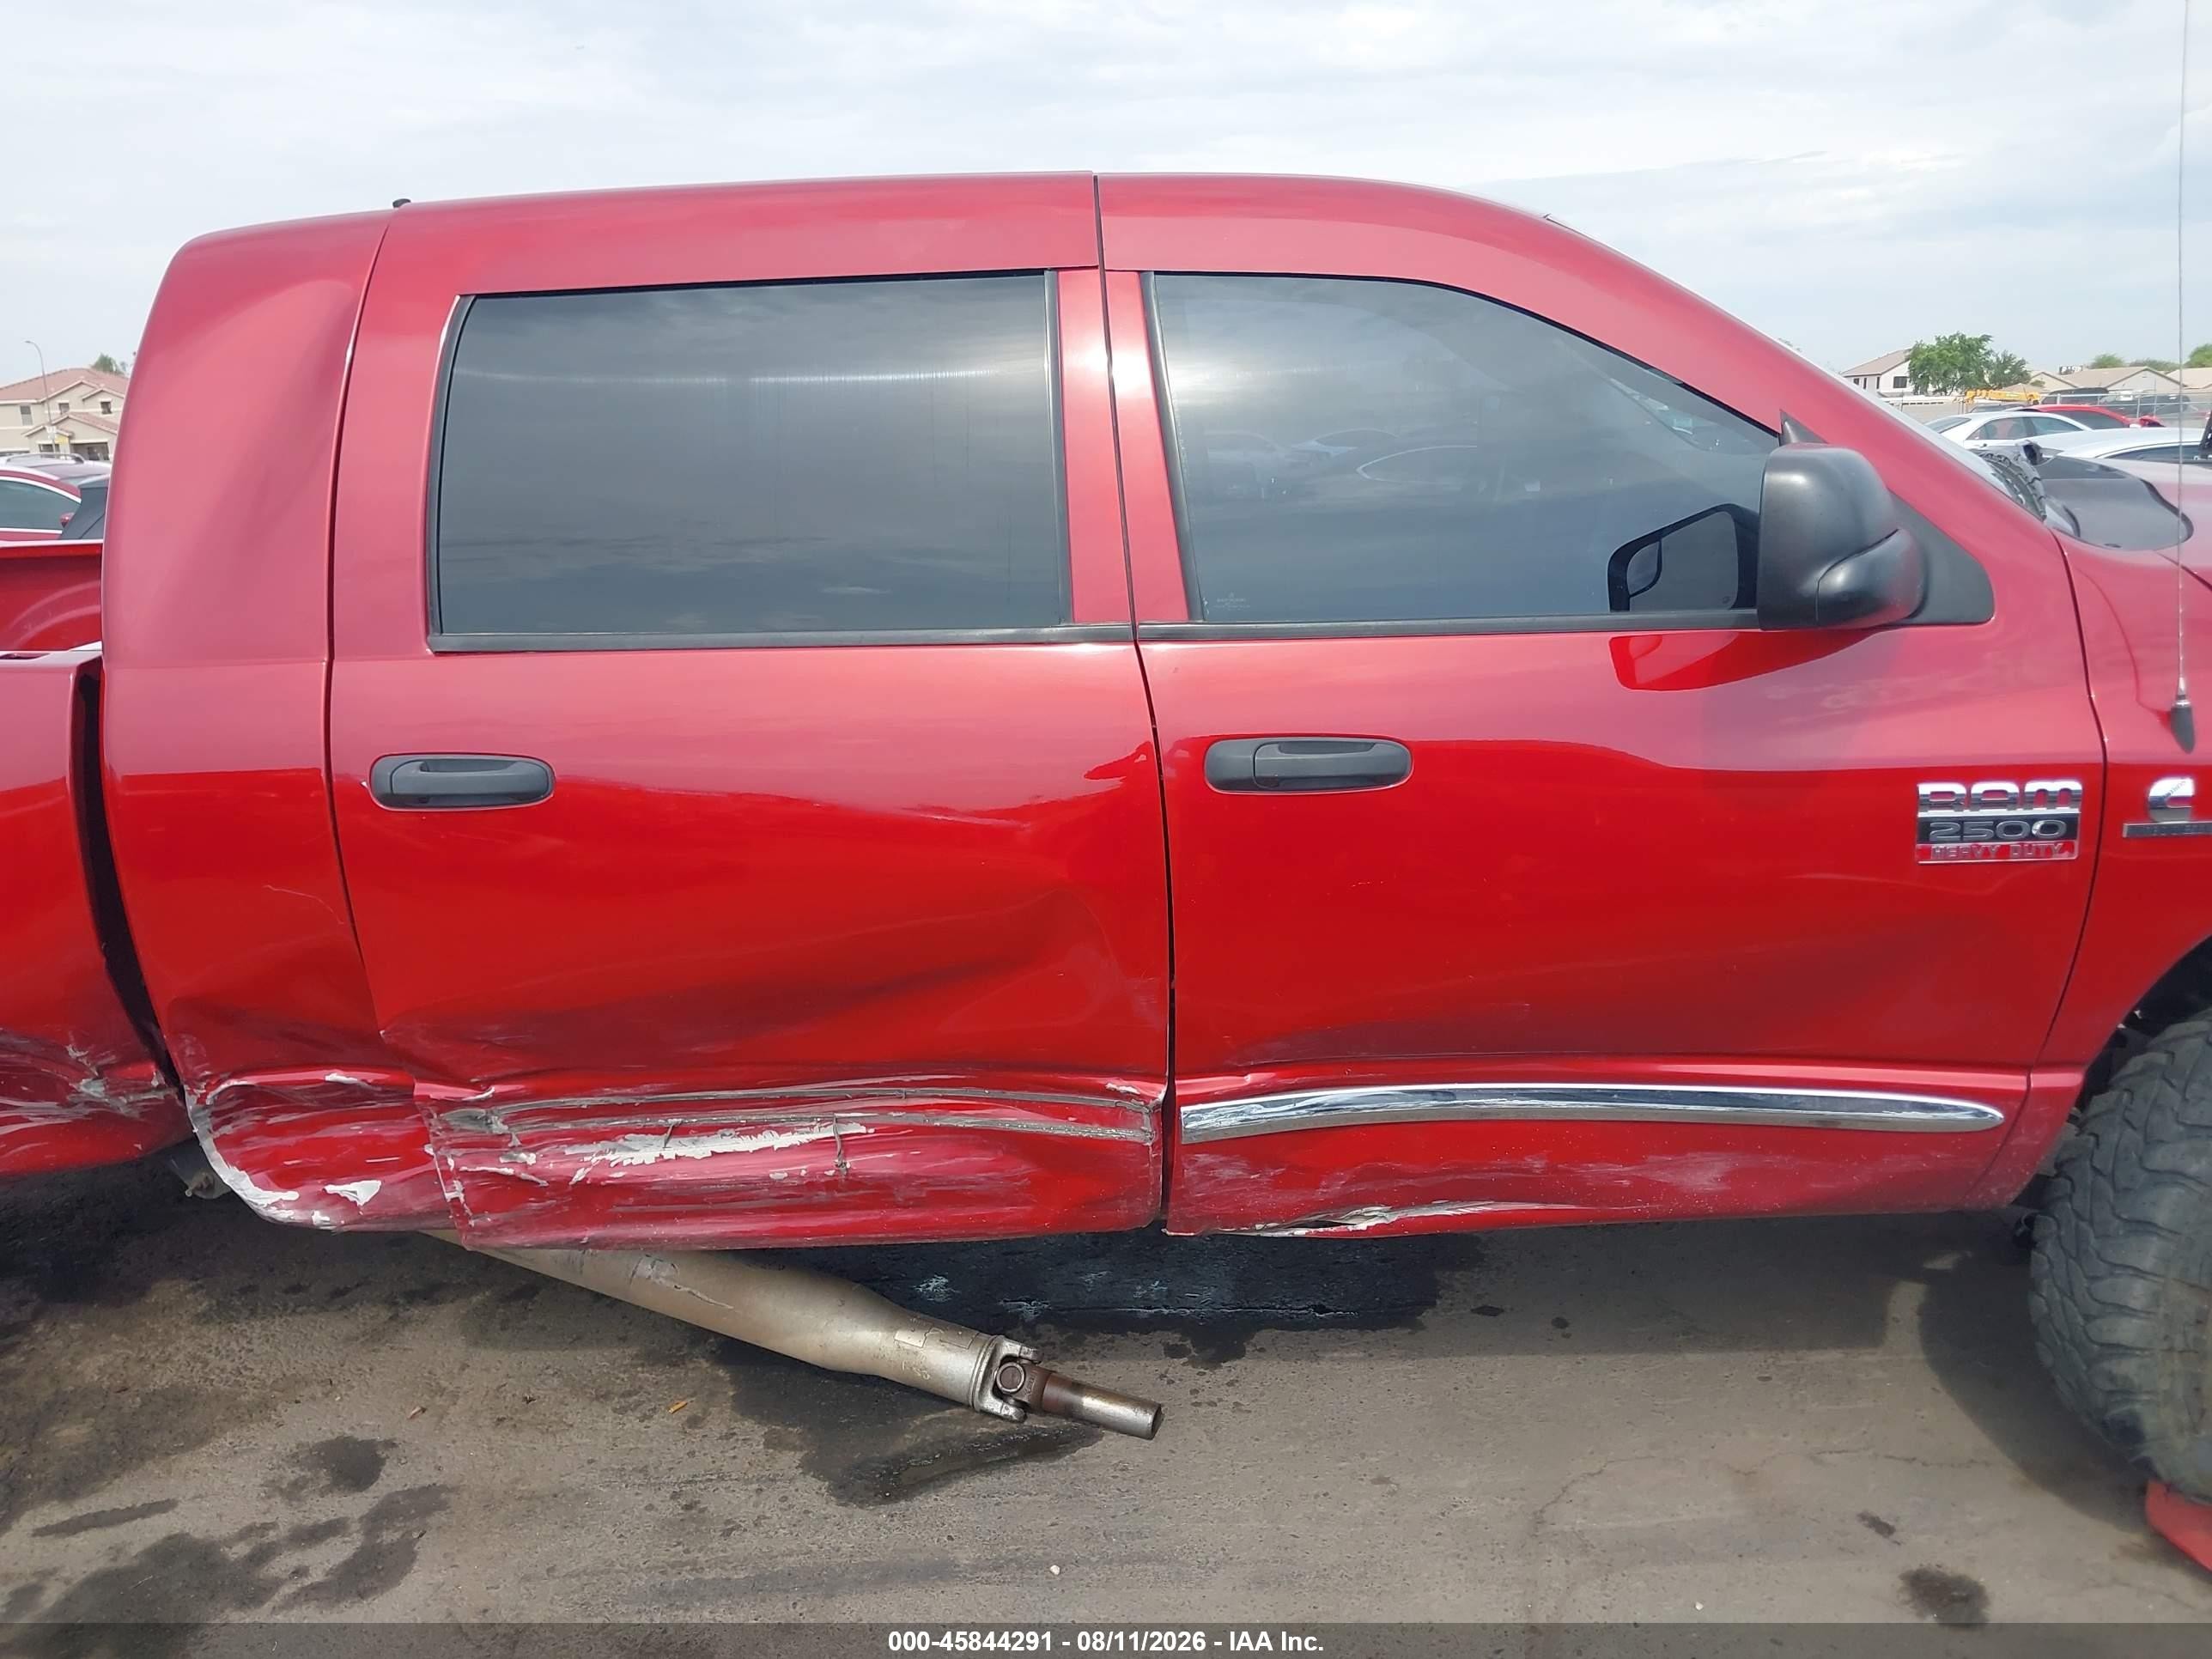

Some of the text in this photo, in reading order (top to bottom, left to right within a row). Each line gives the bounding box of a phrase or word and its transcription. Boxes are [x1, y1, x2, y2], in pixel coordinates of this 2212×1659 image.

[1929, 819, 2067, 842] 2500
[1930, 842, 2063, 859] HEAVY DUTY
